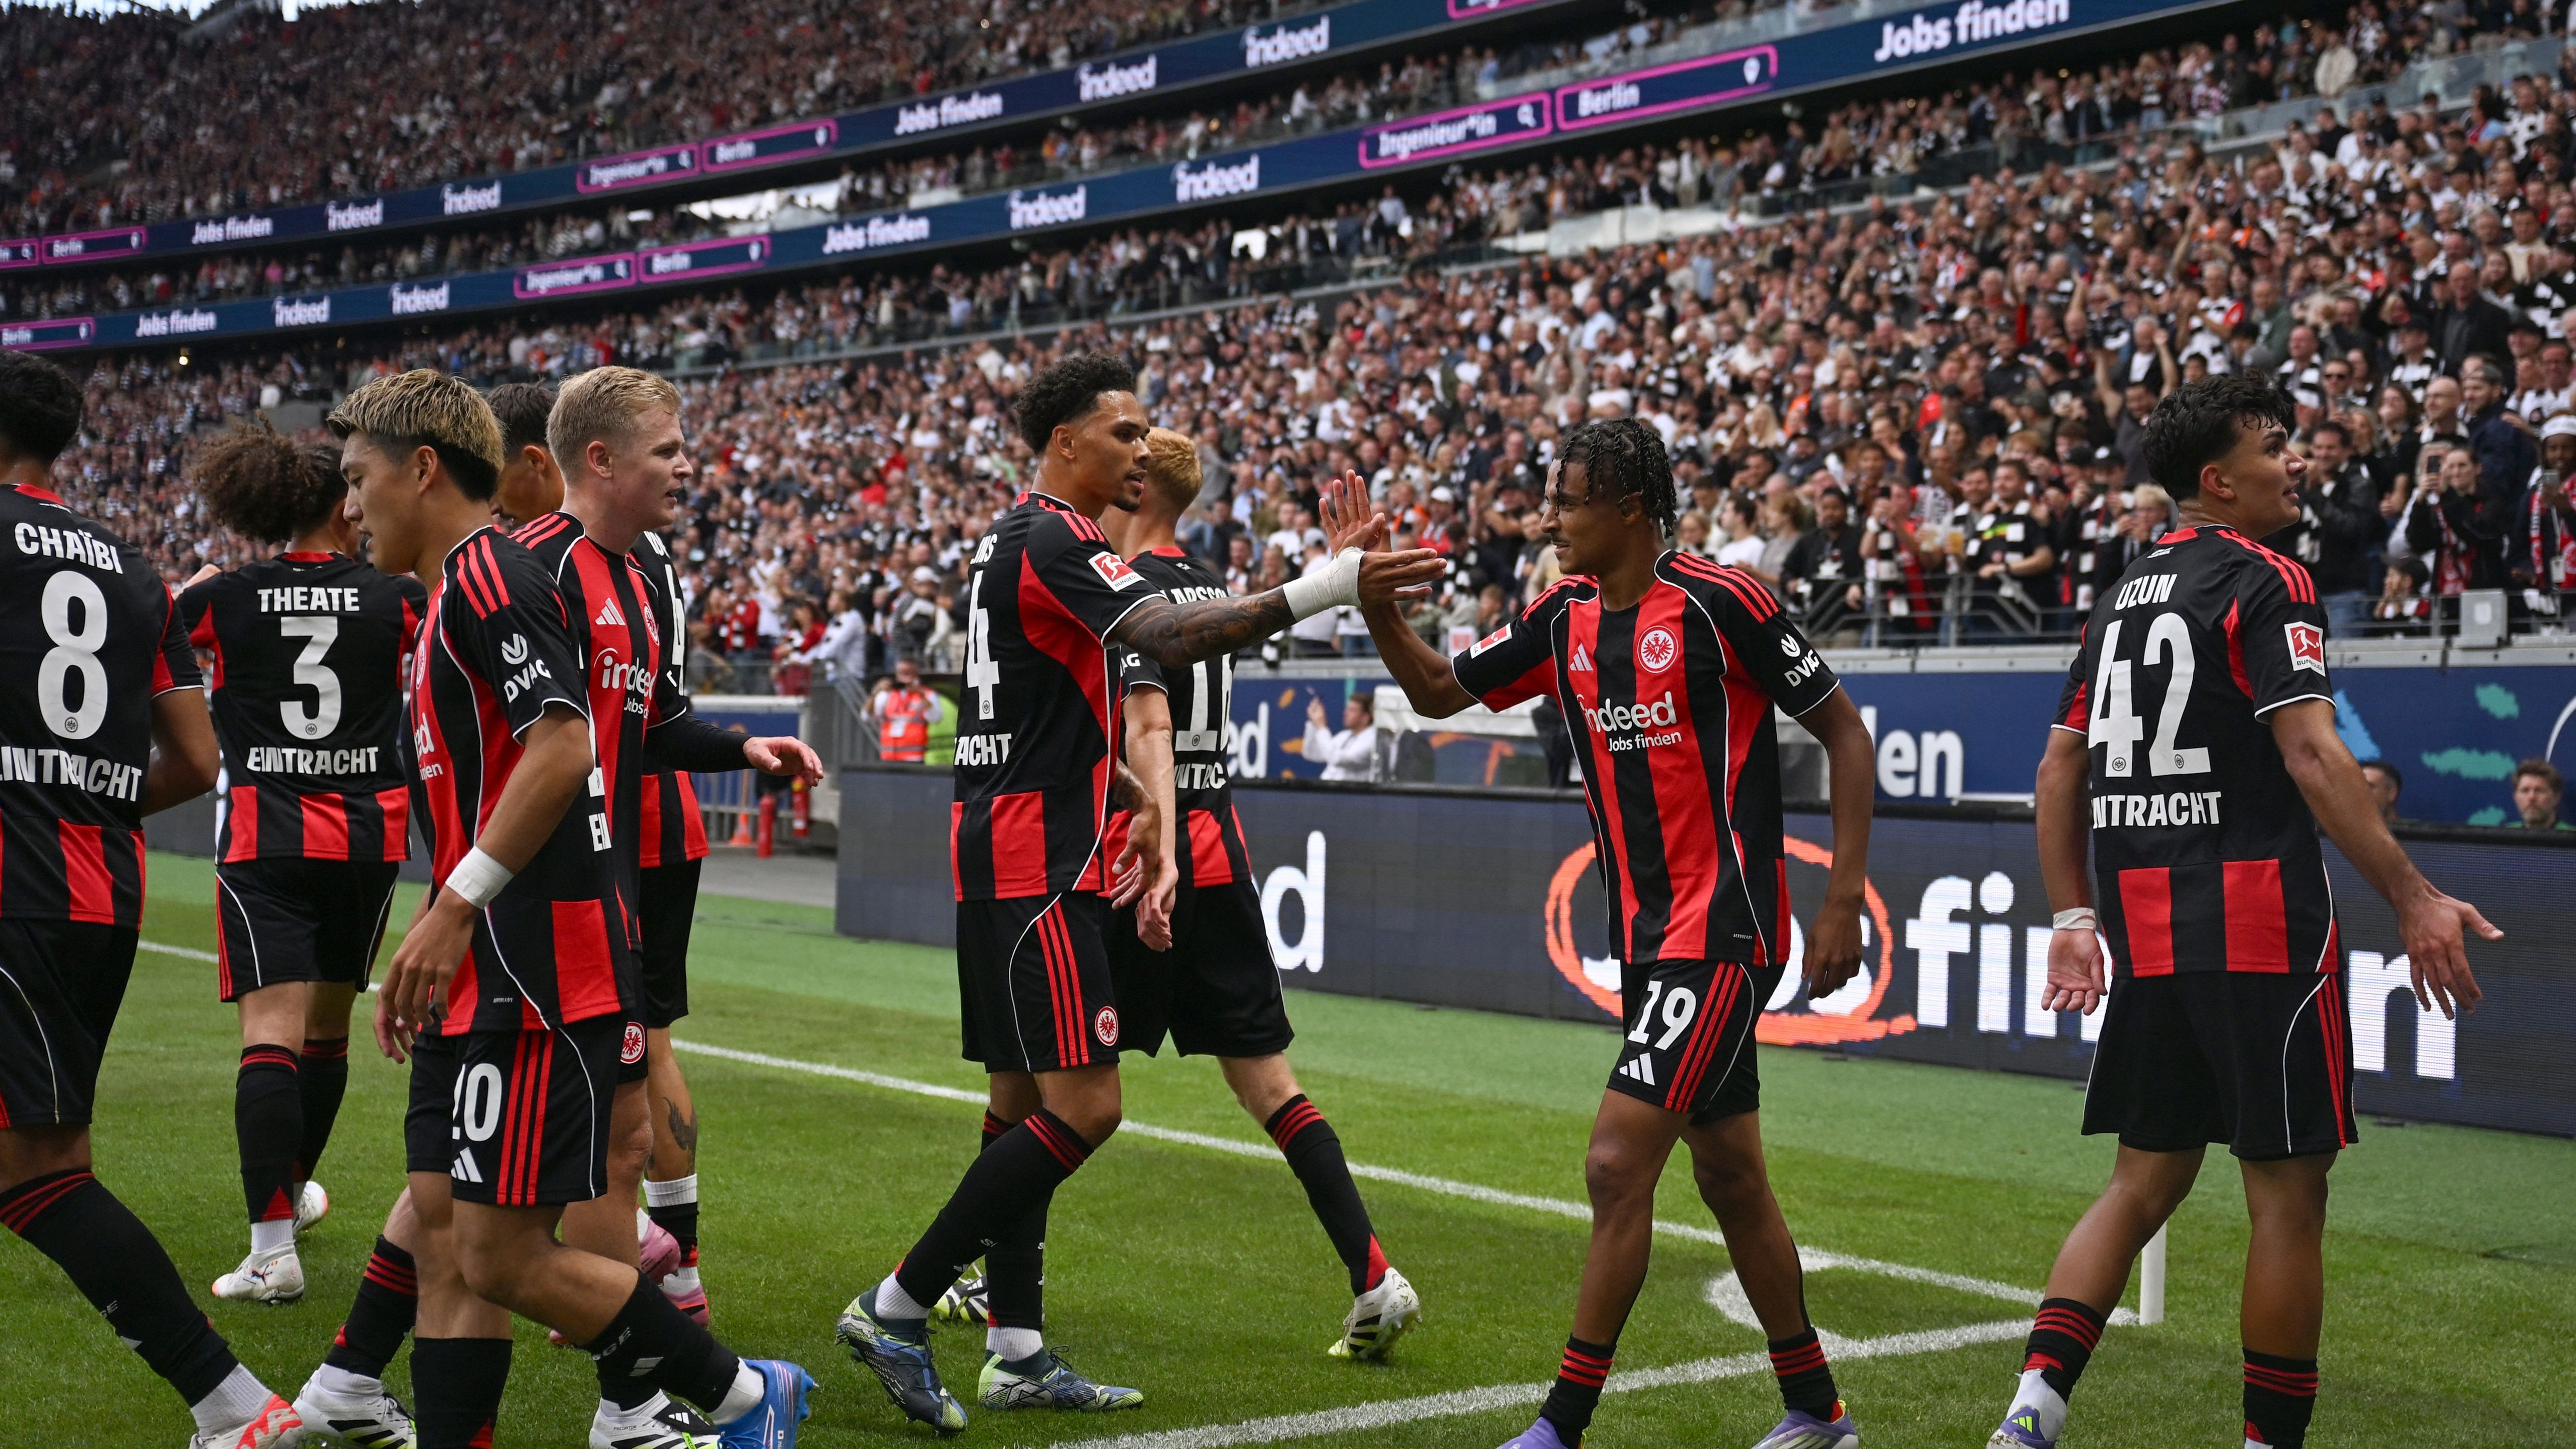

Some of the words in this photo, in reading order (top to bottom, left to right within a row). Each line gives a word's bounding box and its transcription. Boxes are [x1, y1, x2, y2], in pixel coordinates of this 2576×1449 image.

[1244, 16, 1330, 67] indeed
[1874, 17, 1951, 62] Jobs
[1955, 0, 2069, 44] finden
[1078, 54, 1157, 102] indeed
[894, 104, 938, 135] Jobs
[939, 92, 1003, 125] finden
[1578, 82, 1640, 117] Berlin
[715, 138, 756, 164] Berlin
[1174, 153, 1260, 203] indeed
[327, 199, 383, 231] indeed
[443, 181, 501, 215] indeed
[1008, 184, 1087, 230] indeed
[53, 239, 84, 257] Berlin
[192, 221, 225, 244] Jobs
[226, 215, 272, 240] finden
[822, 224, 865, 254] Jobs
[866, 213, 930, 247] finden
[652, 250, 691, 275] Berlin
[273, 296, 330, 327] indeed
[391, 282, 450, 315] indeed
[2, 326, 33, 346] Berlin
[136, 313, 168, 337] Jobs
[169, 308, 217, 333] finden
[14, 522, 123, 575] CHAÏBI
[257, 587, 360, 613] THEATE
[2114, 573, 2178, 611] UZUN
[38, 570, 108, 739] 8
[966, 570, 1000, 721] 4
[280, 616, 341, 740] 3
[503, 658, 552, 704] DVAG
[1783, 648, 1820, 687] DVAG
[1577, 691, 1677, 733] indeed
[2087, 612, 2211, 778] 42
[246, 746, 379, 775] EINTRACHT
[953, 733, 1012, 767] ACHT
[1608, 736, 1633, 752] Jobs
[1635, 731, 1683, 749] finden
[0, 745, 142, 802] INTRACHT
[2091, 791, 2222, 830] NTRACHT
[1627, 980, 1697, 1051] 19
